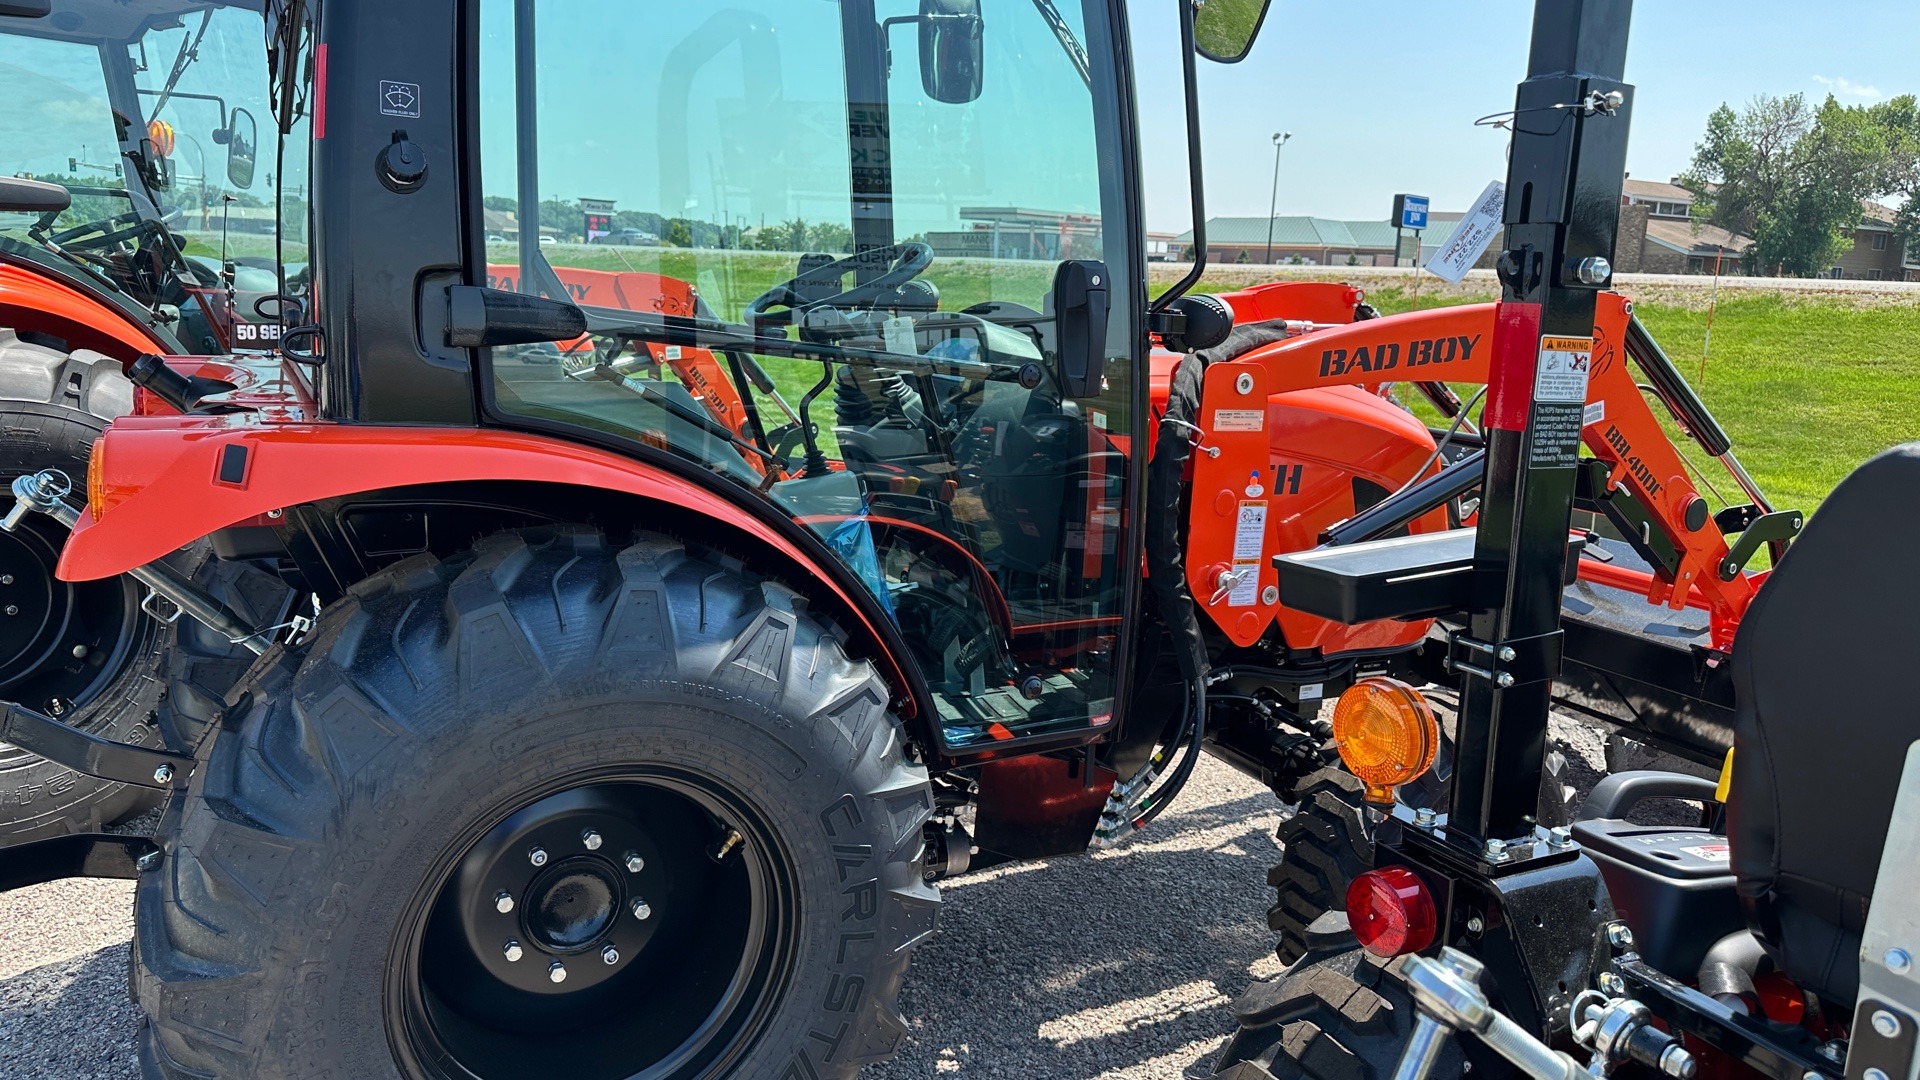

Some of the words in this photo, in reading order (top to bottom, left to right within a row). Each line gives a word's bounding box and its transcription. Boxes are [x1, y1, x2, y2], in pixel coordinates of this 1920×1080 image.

[237, 325, 257, 340] 50
[260, 325, 287, 340] SER
[1556, 340, 1589, 350] WARNING
[1319, 343, 1400, 377] BAD
[1407, 334, 1481, 367] BOY
